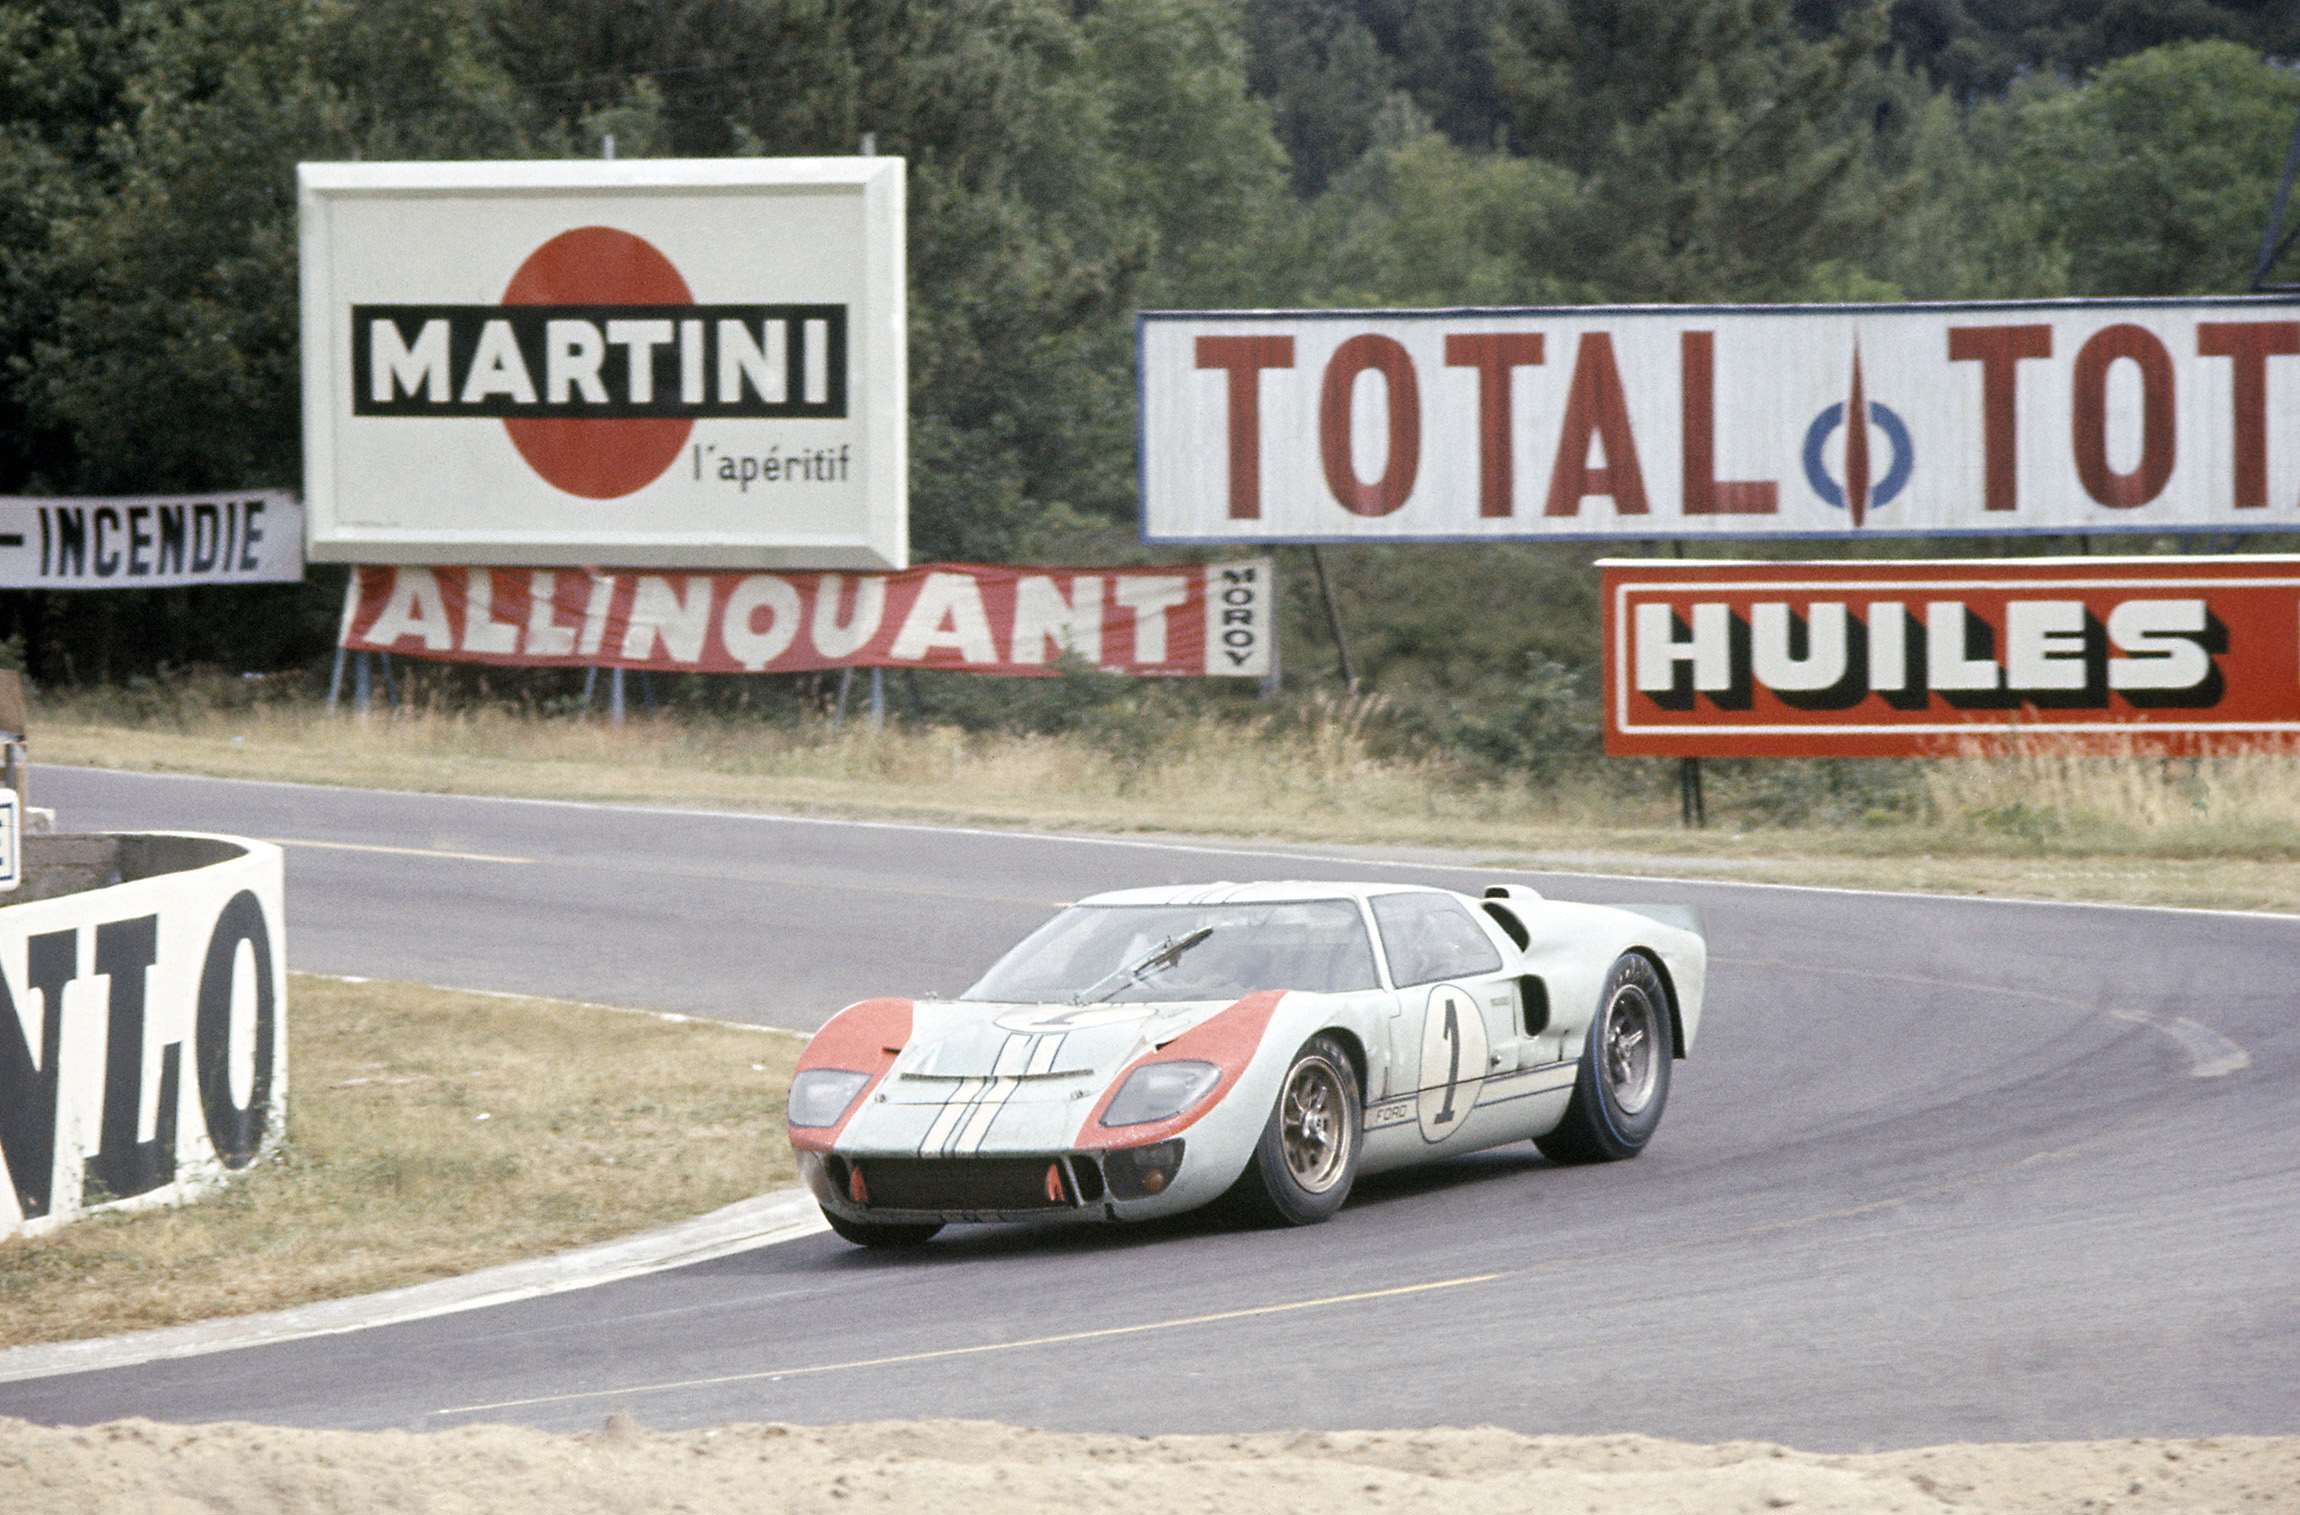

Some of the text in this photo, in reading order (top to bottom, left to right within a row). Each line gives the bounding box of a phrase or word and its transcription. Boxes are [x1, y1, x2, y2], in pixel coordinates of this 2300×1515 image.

[369, 318, 829, 405] MARTINI
[693, 443, 850, 492] l'apéritif
[1194, 331, 1779, 520] TOTAL
[1947, 322, 2300, 512] TOT
[362, 564, 1188, 672] ALLINQUANT
[1635, 600, 2216, 696] HUILES
[1376, 1104, 1408, 1121] FORD
[1433, 998, 1460, 1125] 1
